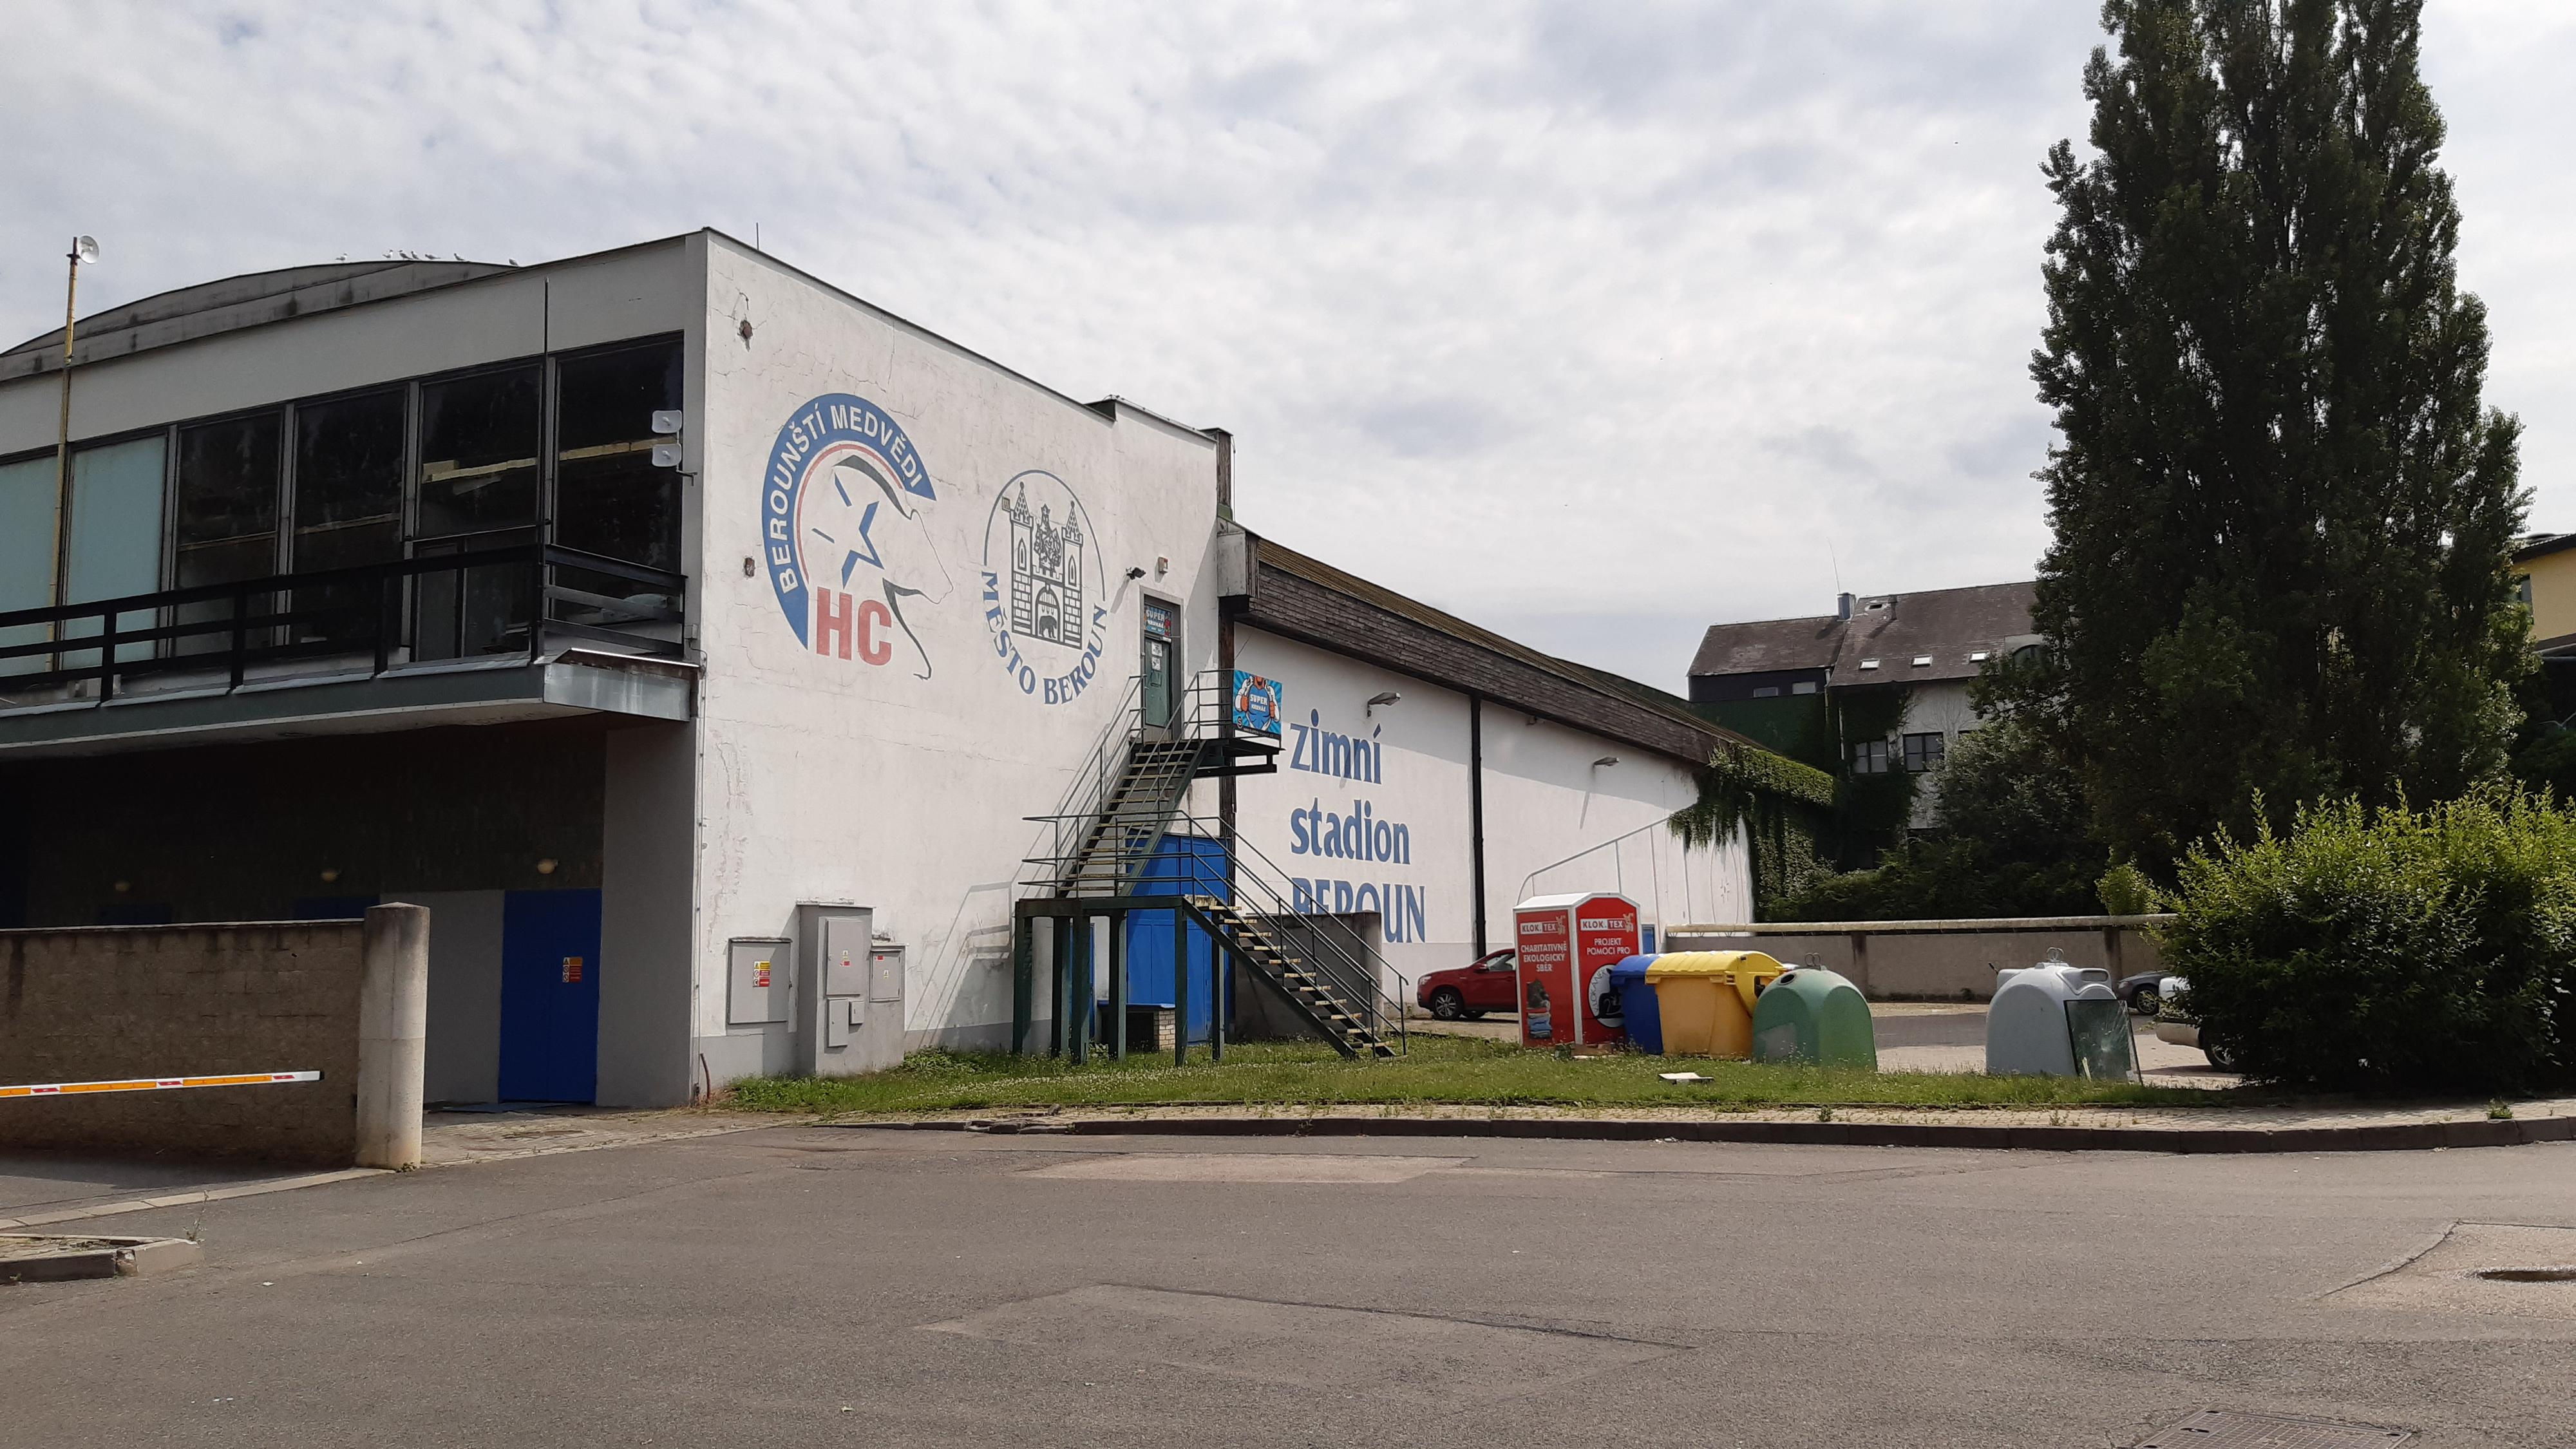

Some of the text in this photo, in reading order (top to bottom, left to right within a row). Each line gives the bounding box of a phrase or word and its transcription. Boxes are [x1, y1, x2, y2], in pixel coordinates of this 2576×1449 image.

[770, 402, 922, 594] BEROUNŠTÍ MEDVĚDI
[816, 586, 892, 667] HC
[981, 571, 1108, 705] MĚSTO BEROUN
[1146, 609, 1165, 621] SUPER
[1249, 694, 1267, 706] SUPER
[1289, 708, 1381, 784] zimní
[1290, 797, 1410, 865] stadion
[1543, 923, 1557, 931] TEX
